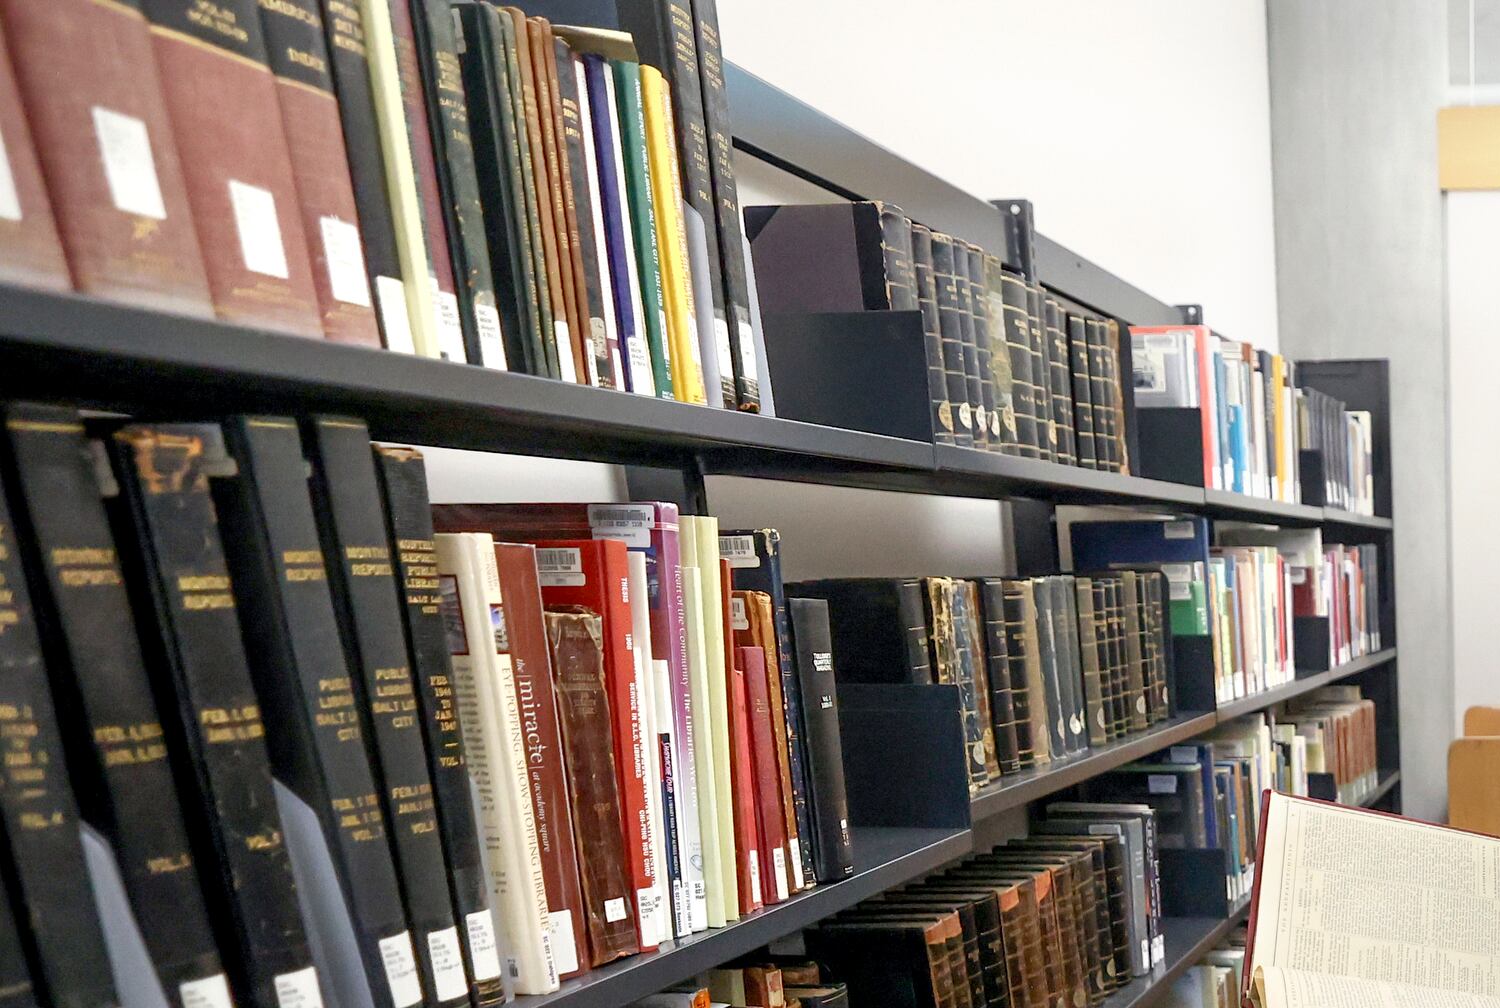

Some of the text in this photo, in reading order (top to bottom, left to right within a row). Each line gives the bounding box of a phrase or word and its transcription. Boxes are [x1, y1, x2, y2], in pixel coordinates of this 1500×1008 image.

[641, 145, 649, 173] PUBLIC
[620, 577, 629, 604] THESIS
[674, 564, 682, 593] Heart
[676, 594, 682, 606] of
[679, 627, 689, 686] Community
[631, 711, 637, 721] IN
[685, 714, 695, 762] Libraries
[633, 744, 642, 779] LIBRARIES
[532, 771, 538, 781] at
[539, 823, 550, 853] square
[639, 809, 647, 841] CHI-PING
